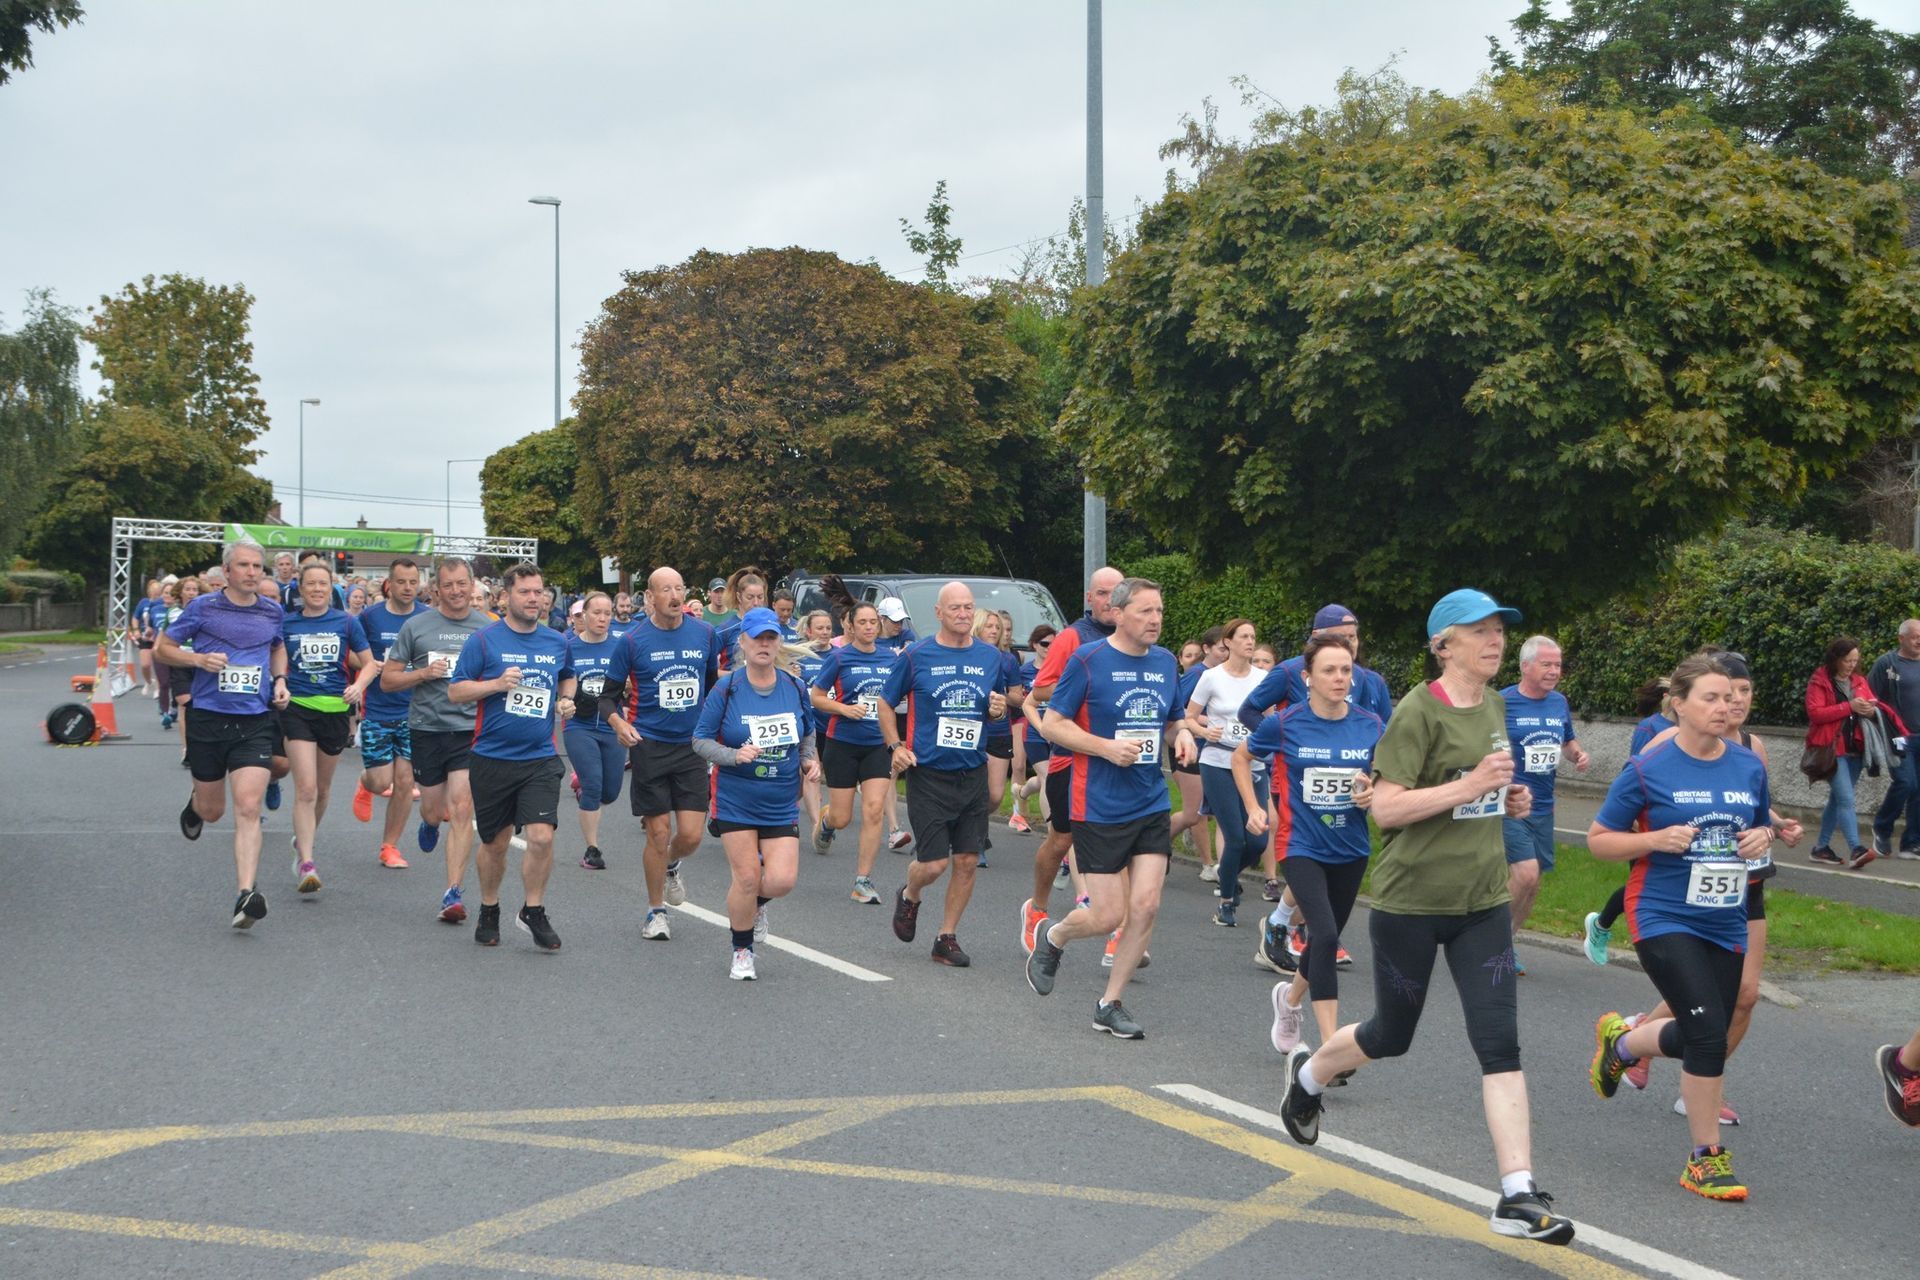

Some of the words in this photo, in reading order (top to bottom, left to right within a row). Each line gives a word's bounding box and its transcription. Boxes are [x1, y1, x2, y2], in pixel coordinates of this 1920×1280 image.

[298, 534, 391, 549] myrunresults
[302, 644, 338, 654] 1060
[682, 650, 702, 659] DNG
[535, 655, 556, 664] DNG
[963, 665, 985, 676] DNG
[220, 672, 259, 685] 1036
[1143, 671, 1165, 683] DNG
[666, 687, 694, 700] 190
[931, 679, 968, 699] Rathfarnham
[513, 693, 544, 708] 926
[1115, 686, 1150, 707] Rathfarnham
[757, 722, 790, 739] 295
[943, 726, 975, 741] 356
[759, 738, 775, 746] DNG
[1341, 749, 1369, 760] DNG
[1531, 753, 1556, 764] 876
[1312, 779, 1352, 793] 555
[1672, 790, 1712, 798] HERITAGE
[1723, 791, 1754, 806] DNG
[1461, 806, 1480, 816] DNG
[1698, 876, 1739, 894] 551
[1696, 895, 1719, 904] DNG
